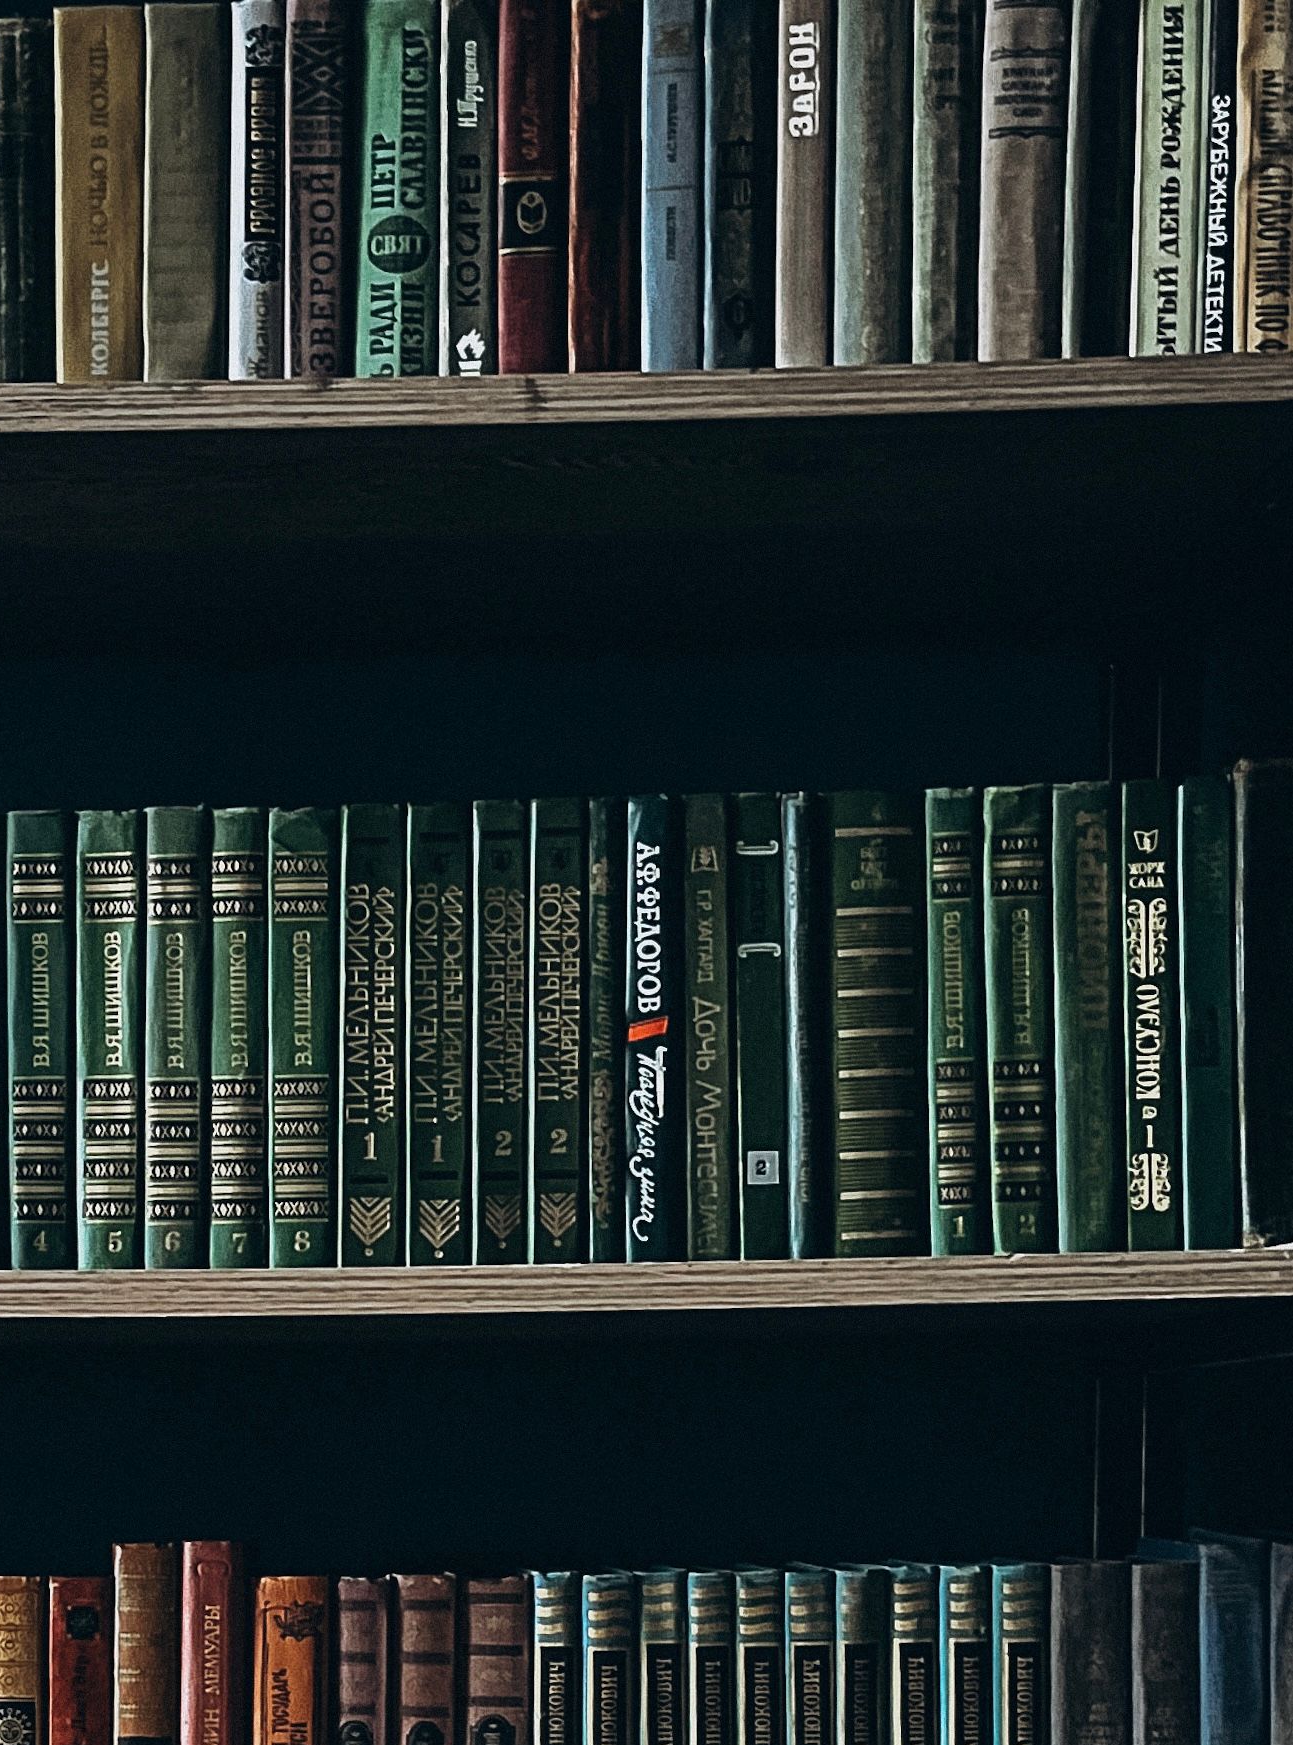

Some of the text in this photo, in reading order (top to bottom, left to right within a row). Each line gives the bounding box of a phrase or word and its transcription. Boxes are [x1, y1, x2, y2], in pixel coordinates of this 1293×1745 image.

[401, 27, 428, 209] СЛАВИНСКИ
[1160, 5, 1185, 169] РОЖДЕНИЯ
[249, 148, 276, 234] ГРОЗНОЕ
[371, 134, 396, 208] ПЕТР
[1159, 177, 1181, 257] ДЕНЬ
[1208, 94, 1230, 245] ЗАРУБЕЖНЫЙ
[303, 172, 335, 372] ЗВЕРОБОЙ
[457, 154, 481, 307] КОСАРЕВ
[91, 263, 109, 375] КОЛБЕРГС
[1255, 304, 1285, 331] ПО
[346, 884, 370, 1124] П.И. МЕЛЬНИКОВ
[693, 996, 720, 1070] Дочь
[1135, 984, 1161, 1100] КОНСУЭЛО
[109, 1231, 123, 1253] 5
[295, 1231, 310, 1252] 8
[204, 1604, 221, 1696] МЕМУАРЫ
